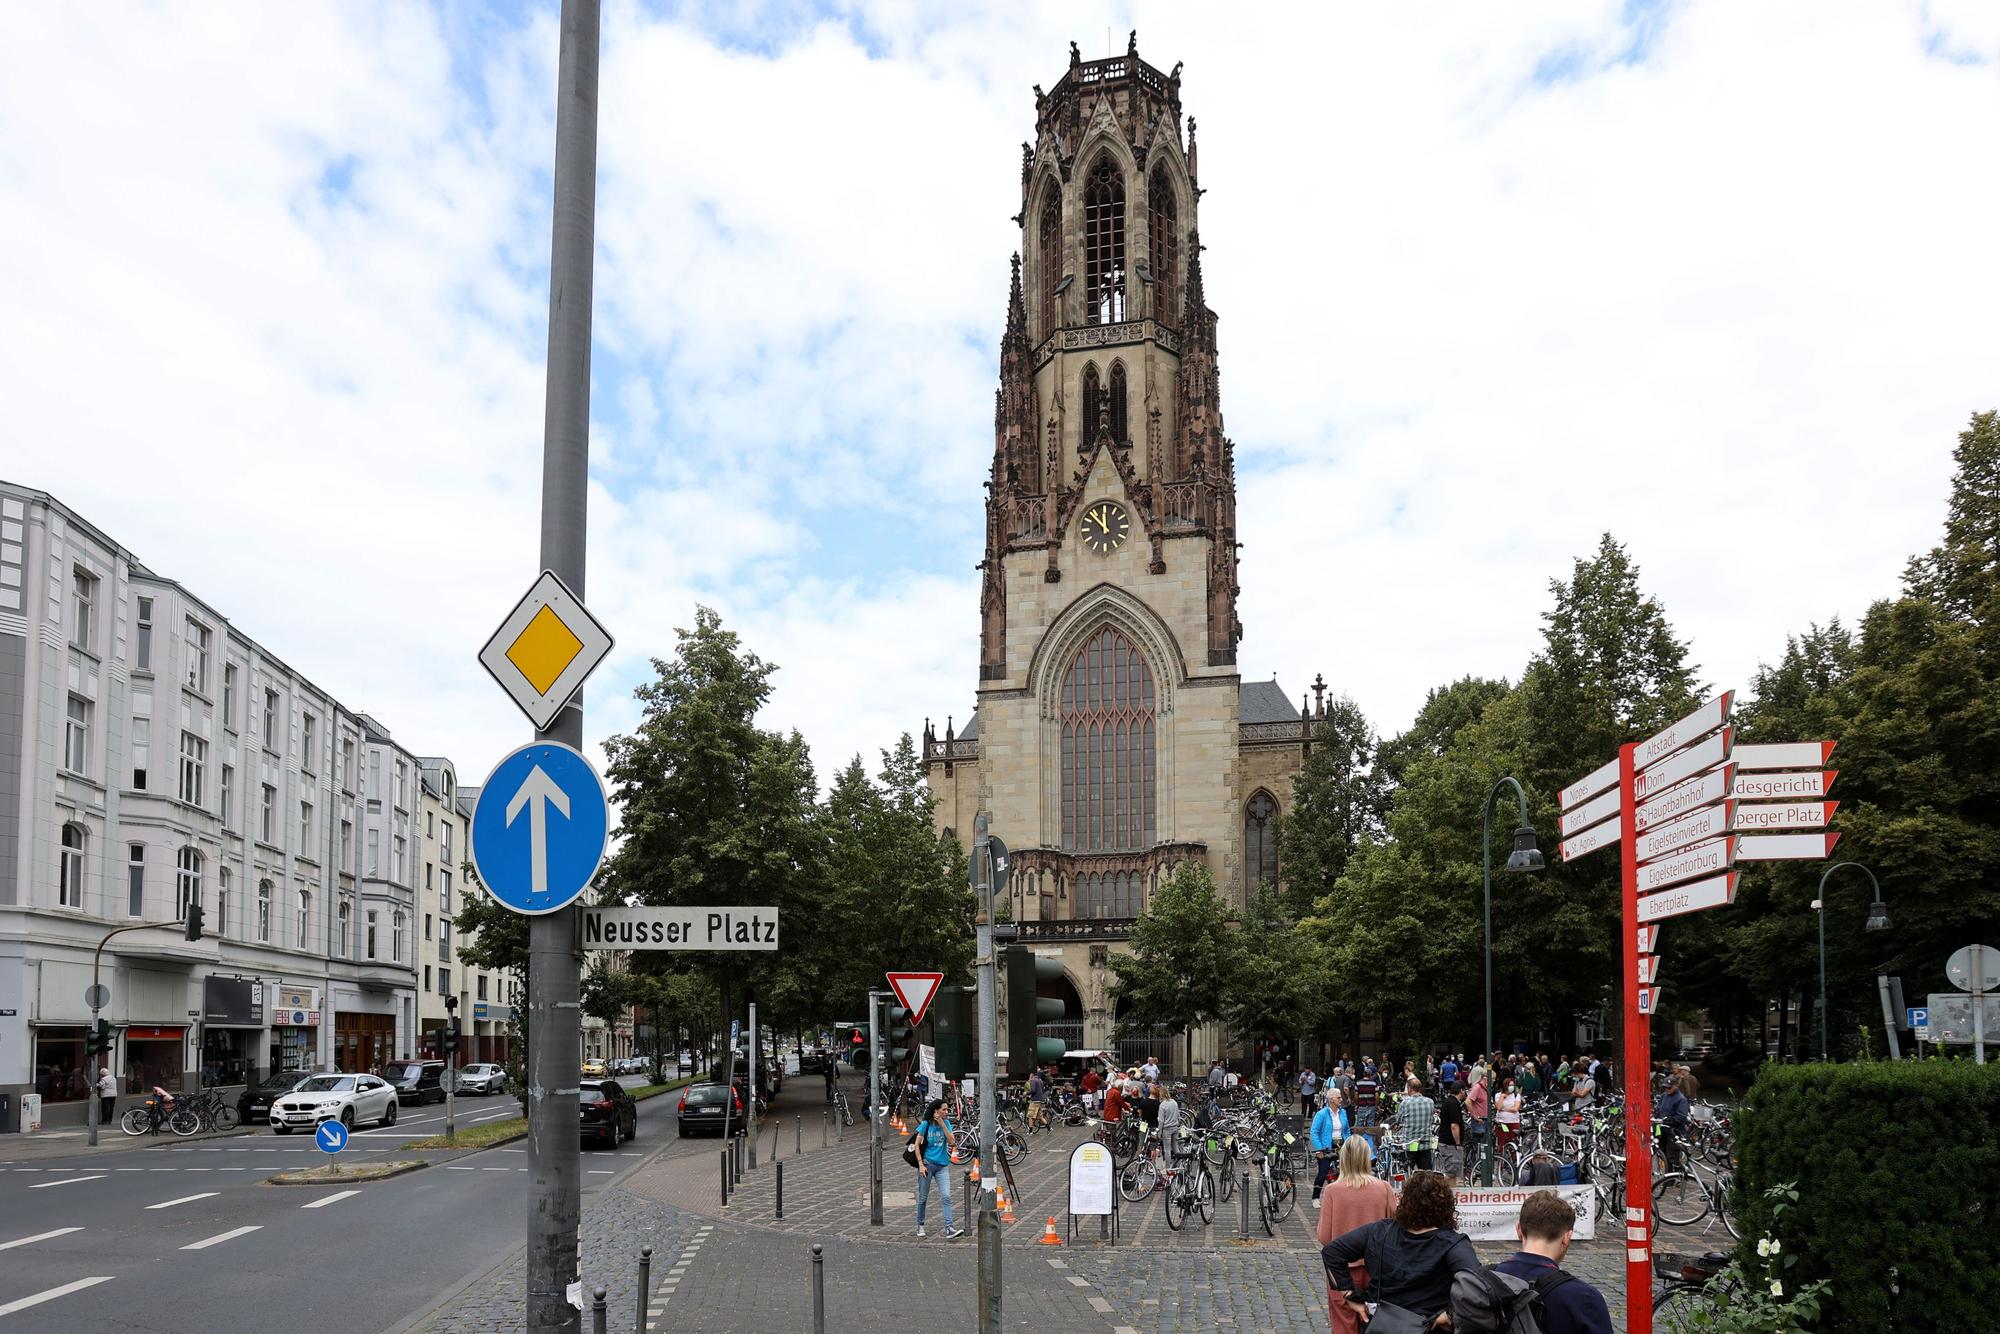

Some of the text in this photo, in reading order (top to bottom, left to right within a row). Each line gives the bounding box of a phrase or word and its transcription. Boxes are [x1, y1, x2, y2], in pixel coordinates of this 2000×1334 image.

[1646, 731, 1676, 760] Altstadt
[1647, 772, 1665, 790] Dom
[1732, 777, 1819, 796] desgericht
[1569, 784, 1589, 801] Nippes
[1648, 782, 1705, 820] Hauptbahnhof
[1570, 814, 1582, 828] Fort
[1735, 808, 1822, 827] perger Platz
[1648, 814, 1711, 853] Eigelsteinviertel
[1571, 835, 1597, 854] St. Agnes
[1649, 852, 1718, 885] Eigelsteintorburg
[1650, 893, 1689, 915] Ebertplatz
[586, 913, 776, 943] Neusser Platz
[1913, 1010, 1926, 1025] P
